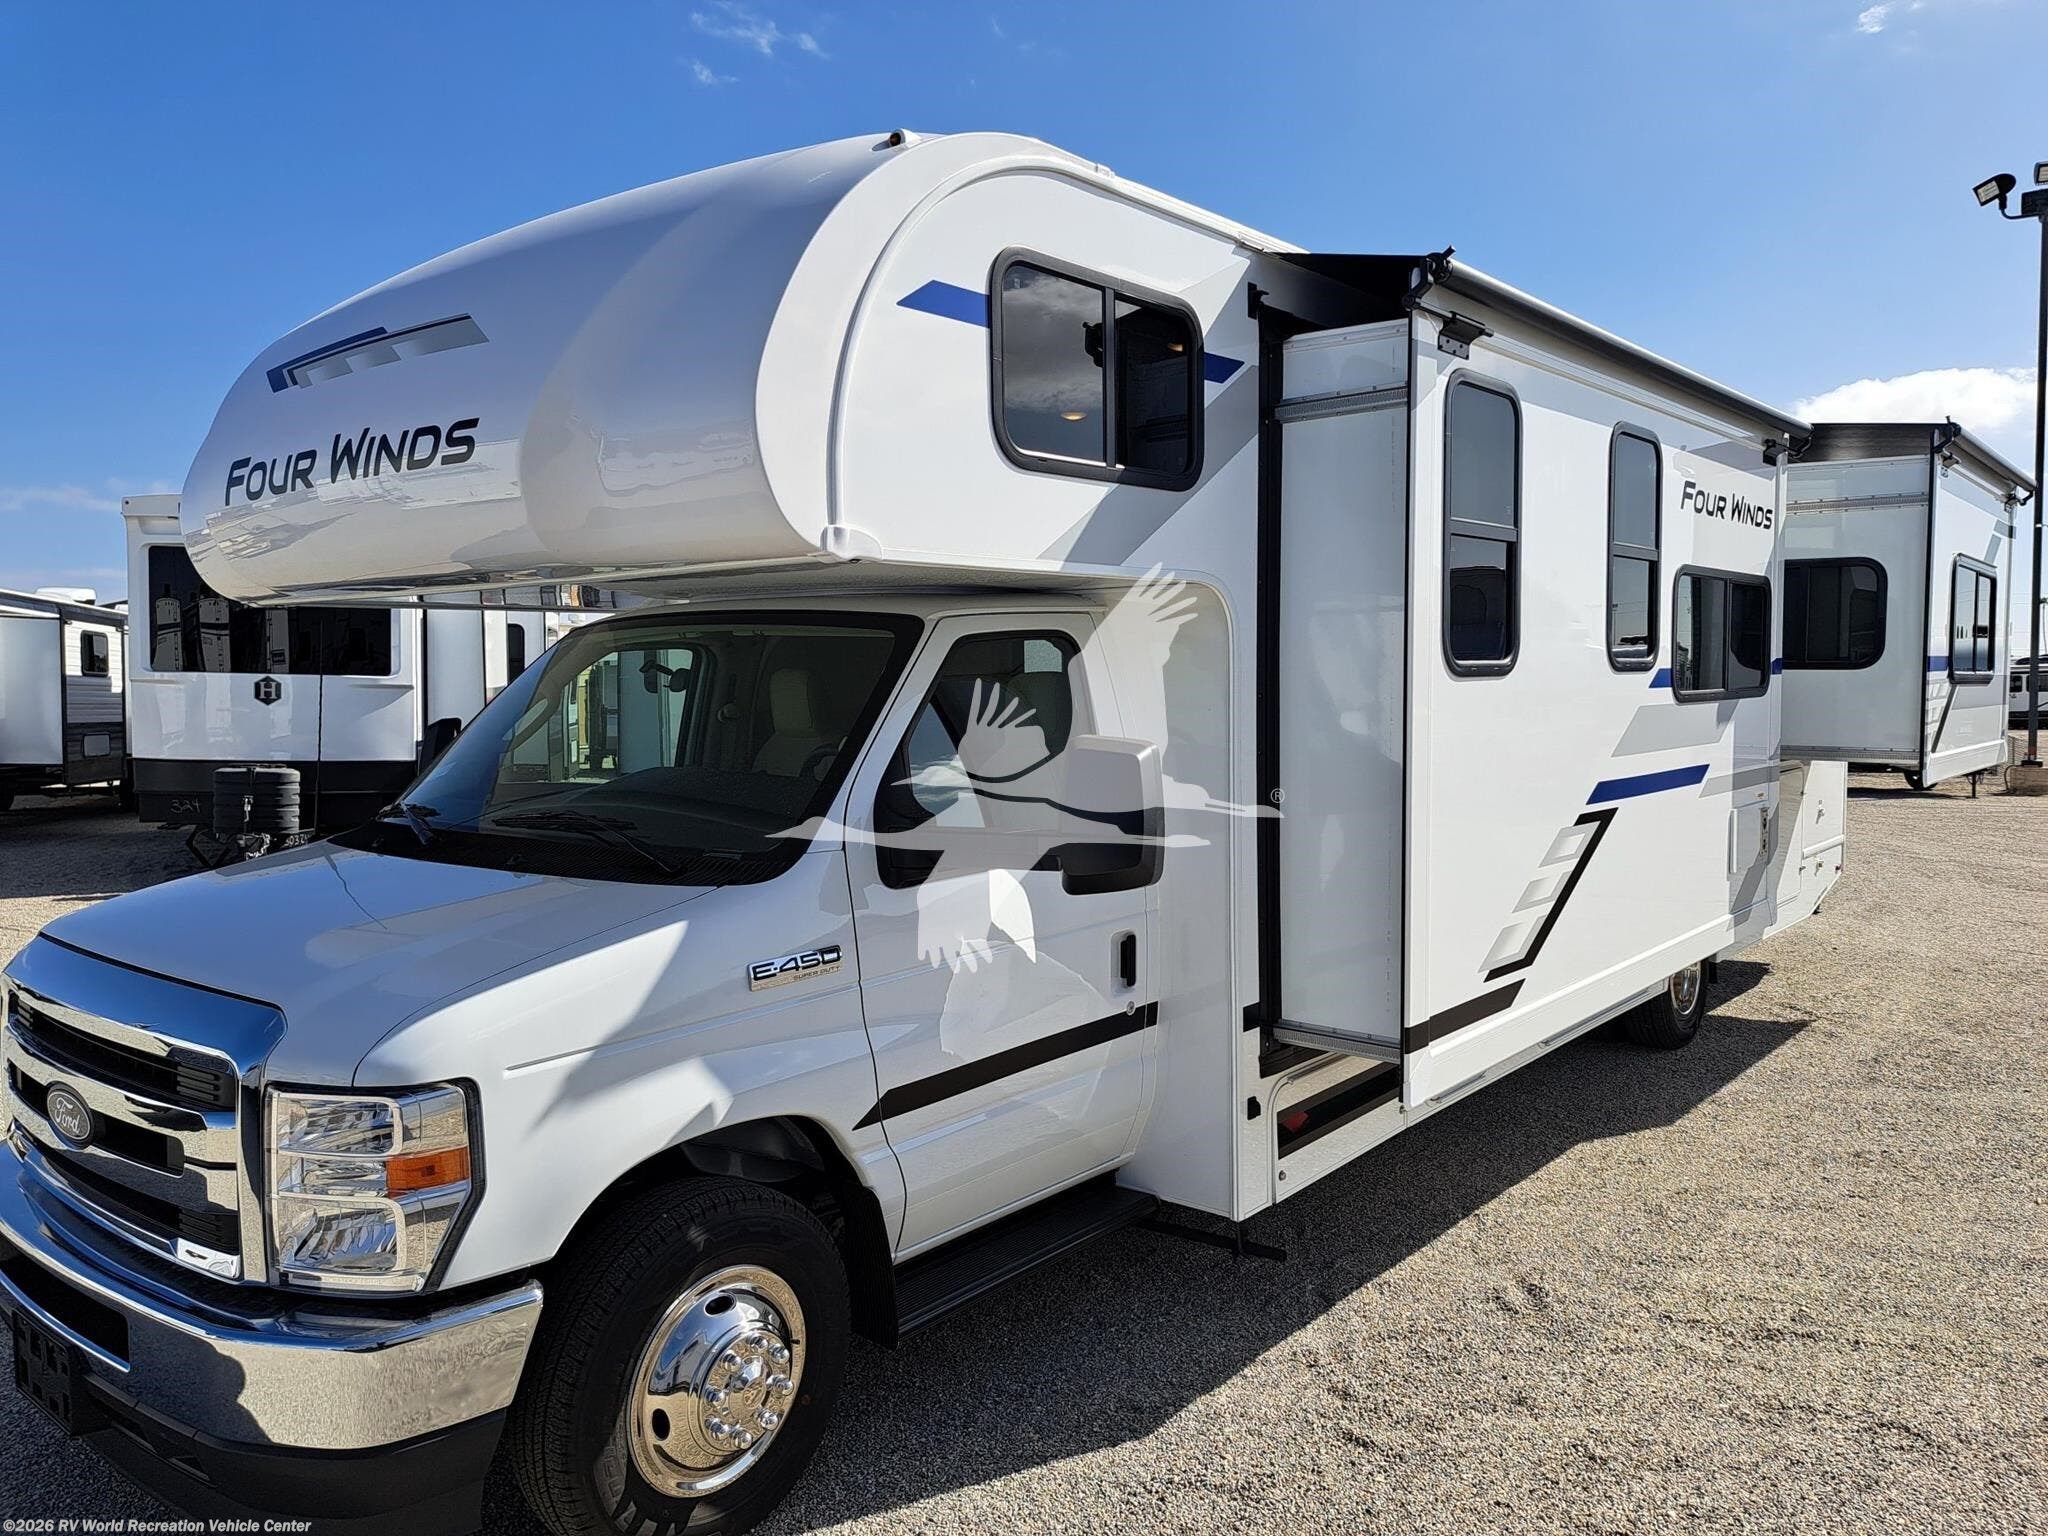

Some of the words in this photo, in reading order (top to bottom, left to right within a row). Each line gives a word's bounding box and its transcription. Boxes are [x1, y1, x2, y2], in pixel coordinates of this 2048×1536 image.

[225, 449, 317, 506] FOUR
[330, 417, 480, 484] WINDS
[1680, 480, 1727, 520] FOUR
[1731, 493, 1773, 530] WINDS
[259, 681, 278, 699] H
[169, 796, 202, 814] 324
[752, 945, 842, 981] E-450
[794, 970, 818, 981] SUPER
[820, 965, 840, 976] DUTY
[54, 1096, 81, 1134] Ford
